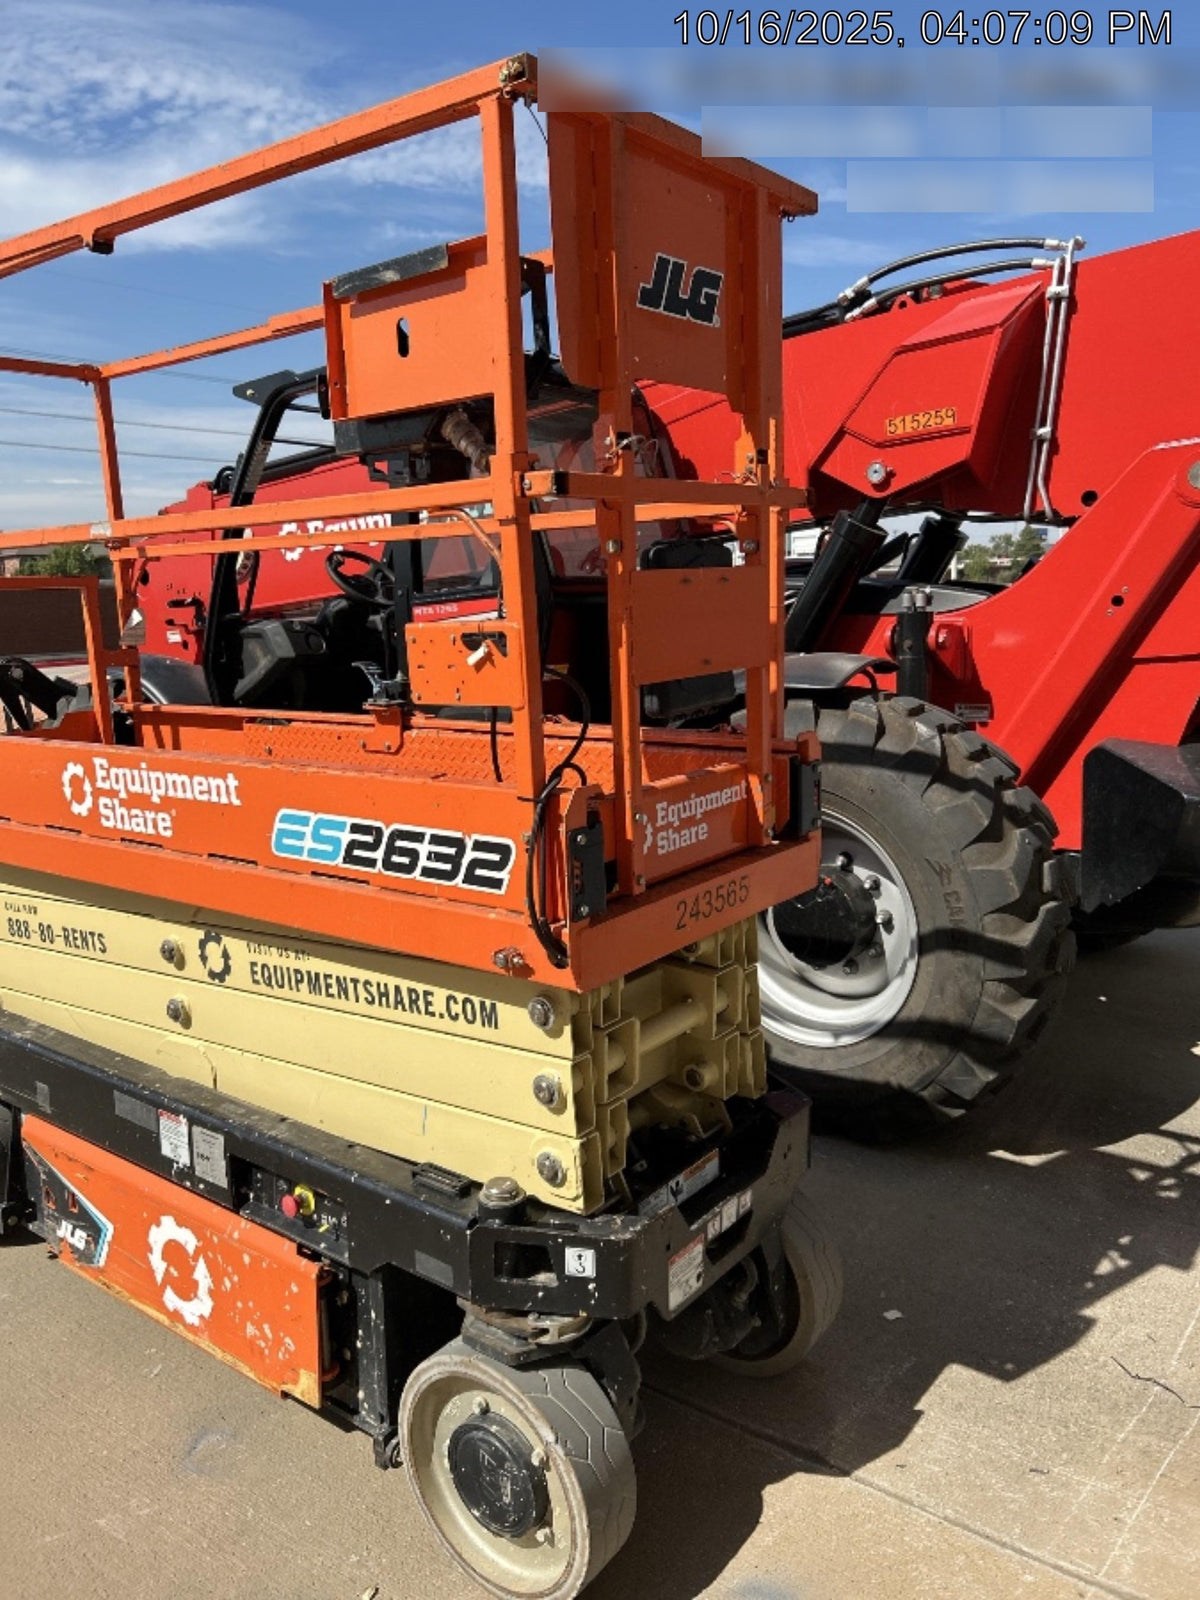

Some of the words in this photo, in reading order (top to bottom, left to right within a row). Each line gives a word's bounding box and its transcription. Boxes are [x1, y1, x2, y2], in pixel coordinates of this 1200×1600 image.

[636, 252, 723, 326] JLG
[887, 407, 957, 435] 515259
[92, 756, 241, 806] Equipment
[656, 779, 748, 827] Equipment
[98, 796, 173, 838] Share
[656, 822, 708, 855] Share
[272, 808, 516, 895] ES2632
[675, 875, 749, 931] 243565
[7, 916, 107, 954] 888-80-RENTS
[276, 946, 290, 959] US
[249, 960, 499, 1030] EQUIPMENTSHARE.COM
[56, 1219, 88, 1250] JLG
